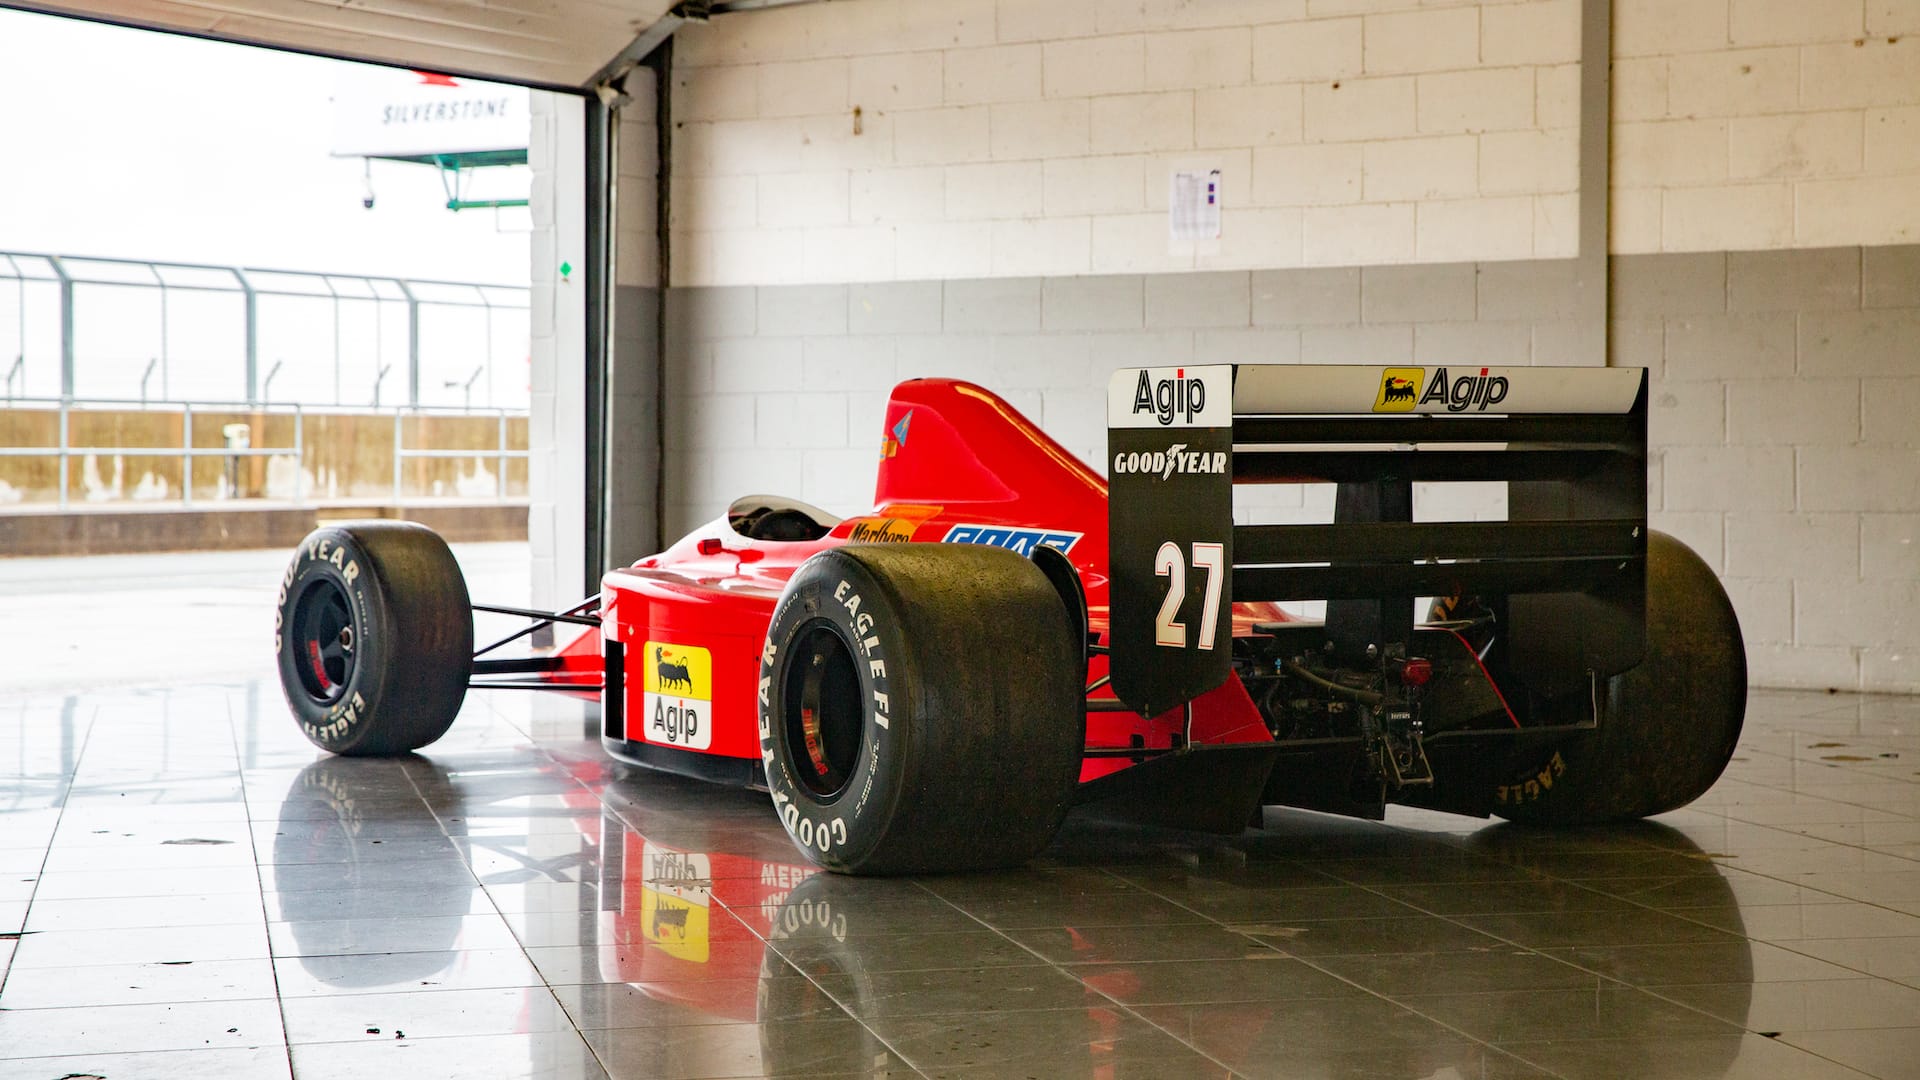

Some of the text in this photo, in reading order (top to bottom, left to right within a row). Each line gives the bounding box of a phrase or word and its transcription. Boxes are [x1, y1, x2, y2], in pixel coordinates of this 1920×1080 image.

[383, 98, 508, 124] SILVERSTONE
[1133, 369, 1205, 425] Agip
[1419, 368, 1508, 411] Agip
[1155, 541, 1223, 650] 27
[834, 579, 887, 679] EAGLE
[319, 691, 366, 743] EAGLE
[653, 696, 697, 743] Agip
[1498, 752, 1567, 804] EAGLE
